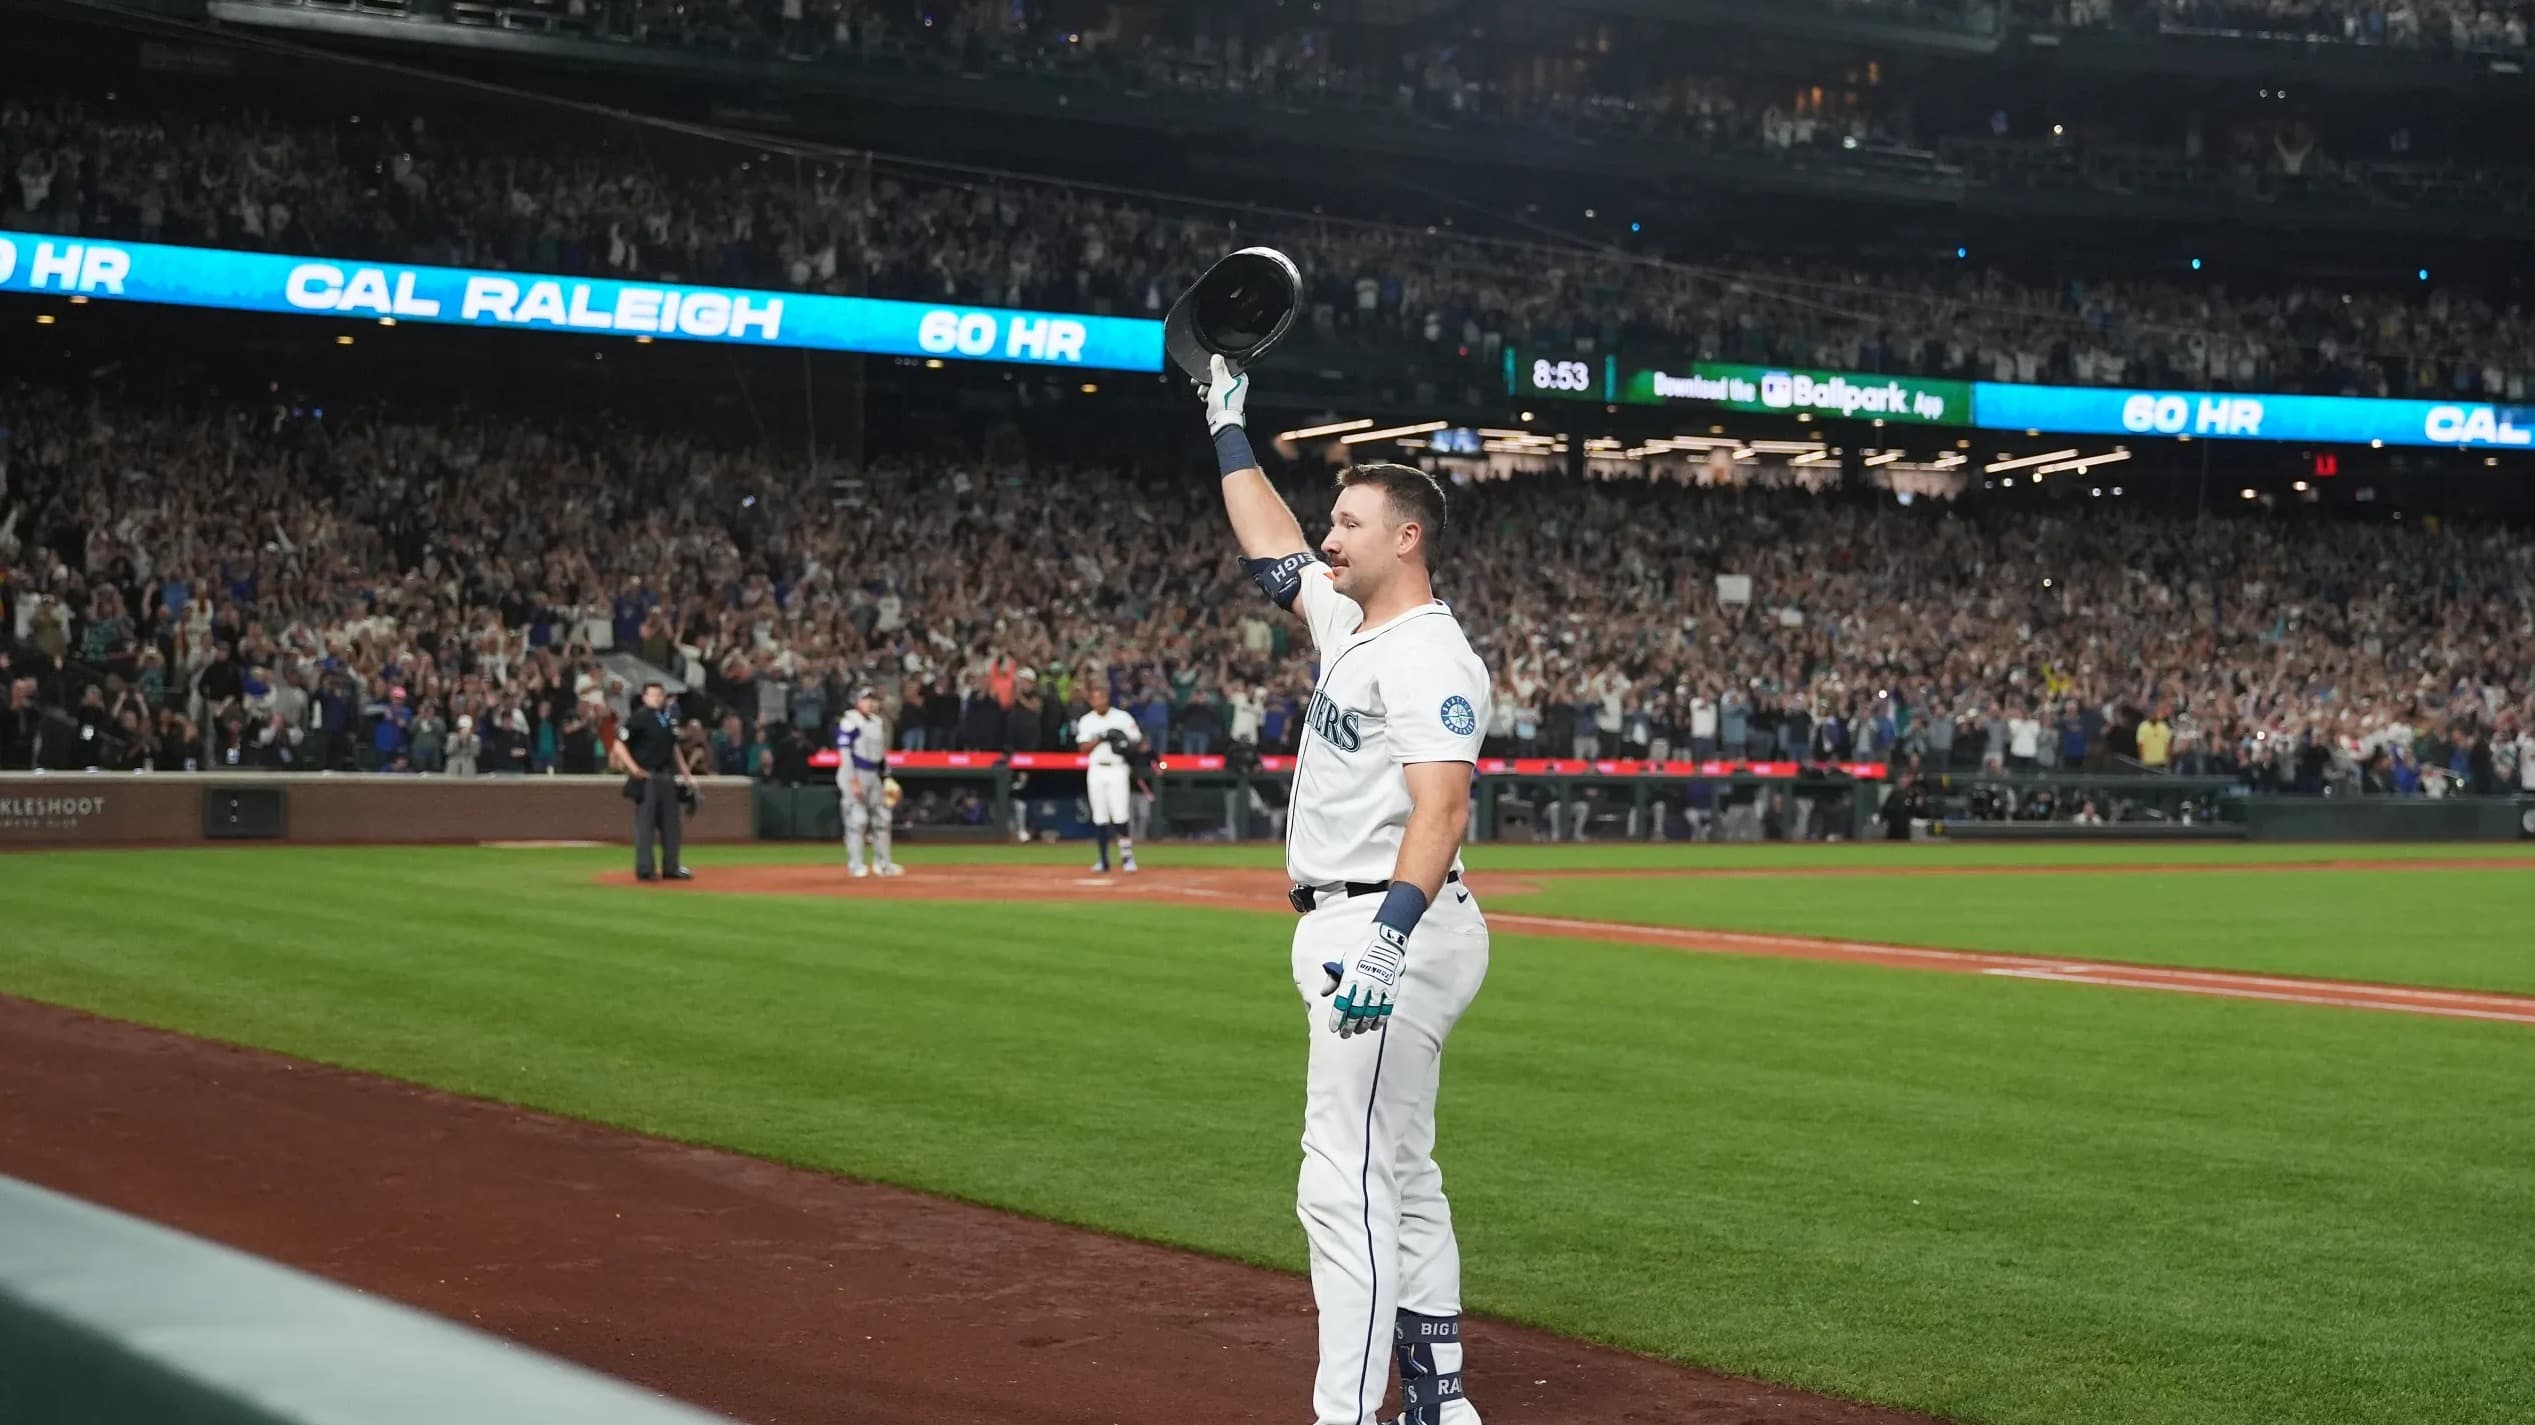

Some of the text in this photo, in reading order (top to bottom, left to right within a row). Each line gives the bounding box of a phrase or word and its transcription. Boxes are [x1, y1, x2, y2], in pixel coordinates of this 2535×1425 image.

[30, 242, 131, 294] HR
[285, 263, 783, 340] CAL RALEIGH
[918, 310, 1087, 362] 60 HR
[1532, 358, 1590, 392] 8:53
[1793, 375, 1908, 416] Ballpark
[1912, 391, 1944, 419] App
[2122, 394, 2264, 435] 60 HR
[2424, 405, 2532, 445] CAL
[1421, 1322, 1449, 1336] BIG
[1438, 1377, 1462, 1396] RA
